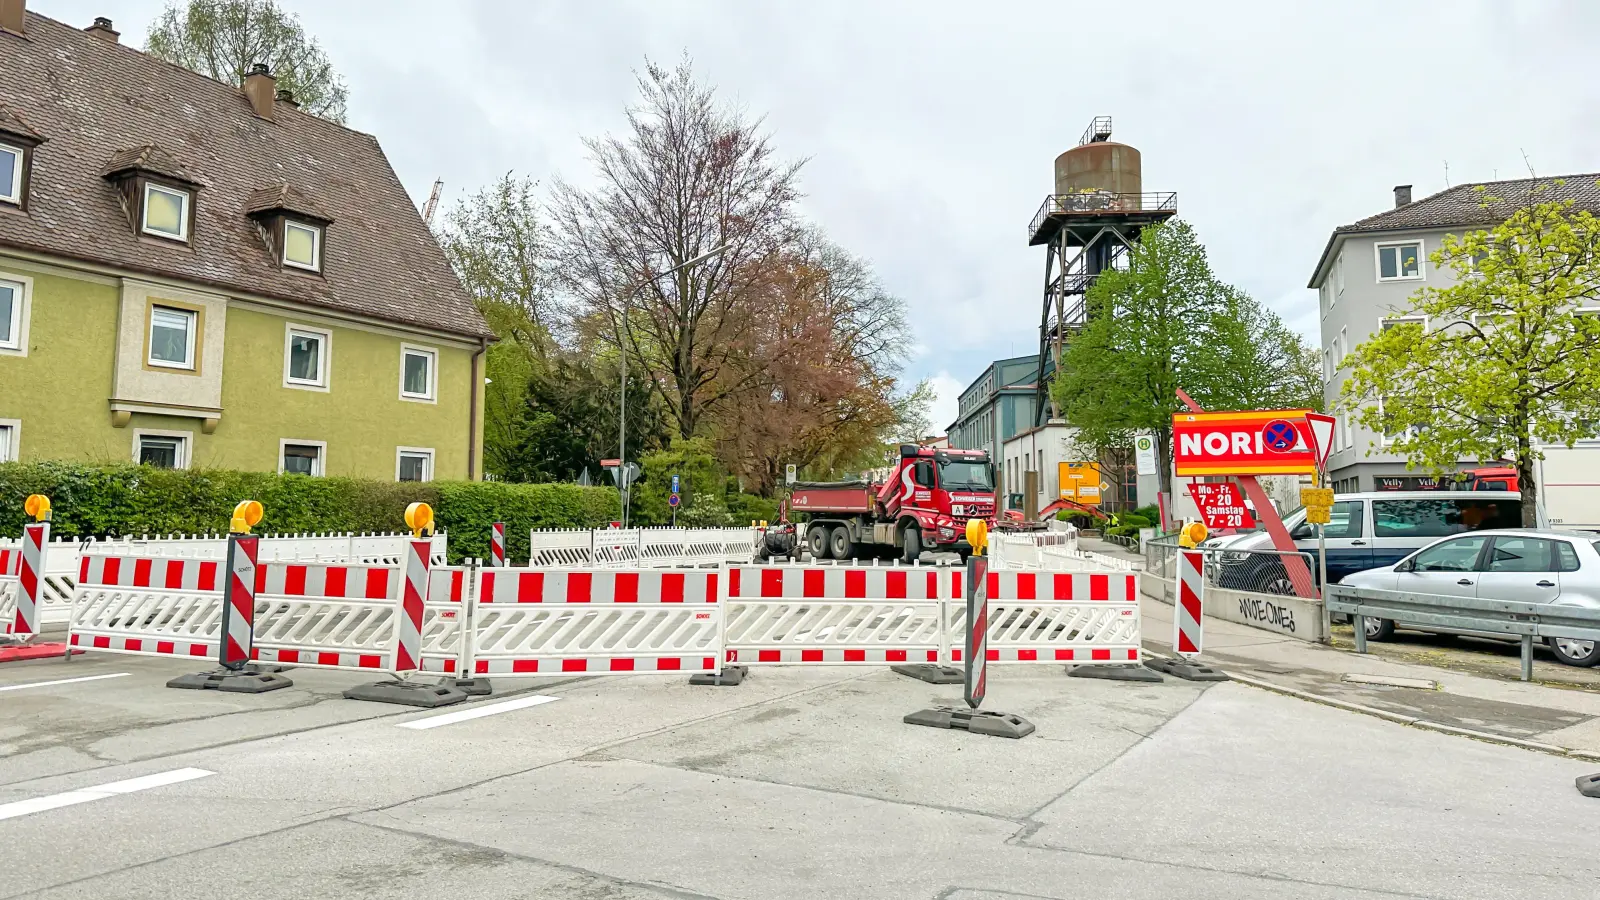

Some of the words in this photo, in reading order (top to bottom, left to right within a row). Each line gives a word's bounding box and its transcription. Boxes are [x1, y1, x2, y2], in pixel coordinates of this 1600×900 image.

[1199, 494, 1206, 505] 7
[1217, 494, 1232, 505] 20
[955, 506, 961, 514] A
[1206, 505, 1244, 515] Samstag
[1208, 515, 1215, 526] 7
[1227, 515, 1242, 526] 20
